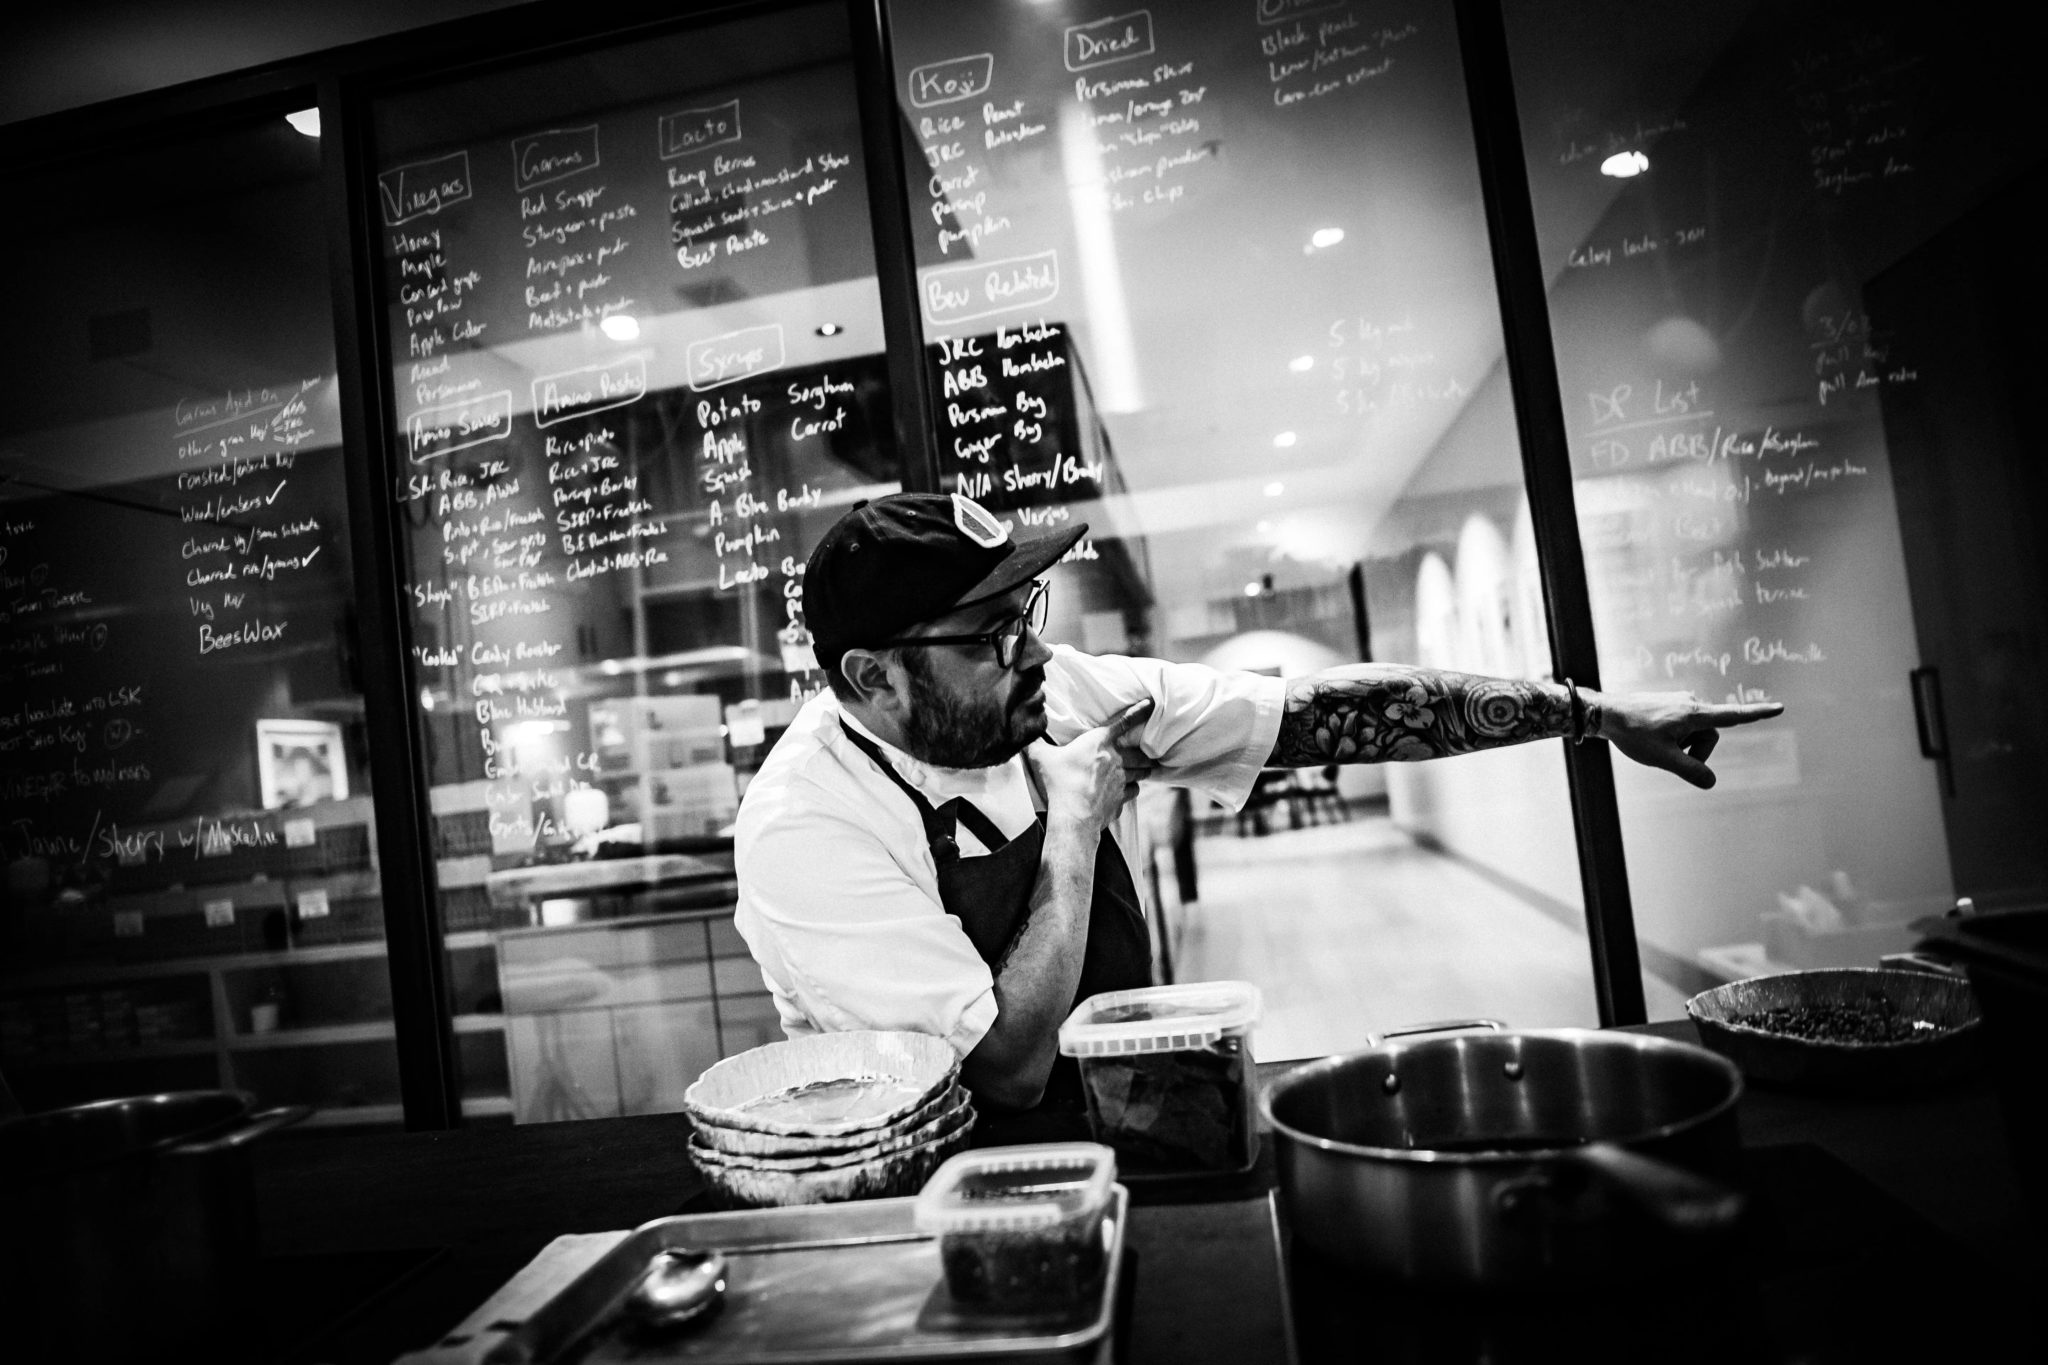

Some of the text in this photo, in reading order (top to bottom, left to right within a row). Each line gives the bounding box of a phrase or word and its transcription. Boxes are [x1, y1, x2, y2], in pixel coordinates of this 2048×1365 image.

[1076, 25, 1139, 61] Dried
[669, 118, 727, 152] Lacto
[920, 116, 966, 140] Rice
[668, 166, 706, 189] Ramp
[522, 193, 548, 219] Red
[393, 229, 441, 255] Honey
[401, 253, 448, 279] Maple
[928, 264, 1055, 312] Bev Related
[699, 348, 765, 380] Syrups
[944, 365, 988, 399] ABB
[697, 374, 856, 428] Potato Sorghum
[1016, 391, 1047, 418] Bug
[791, 406, 848, 441] Carrot
[1014, 419, 1043, 443] Bug
[719, 562, 770, 591] Lacto
[109, 685, 141, 706] LSK
